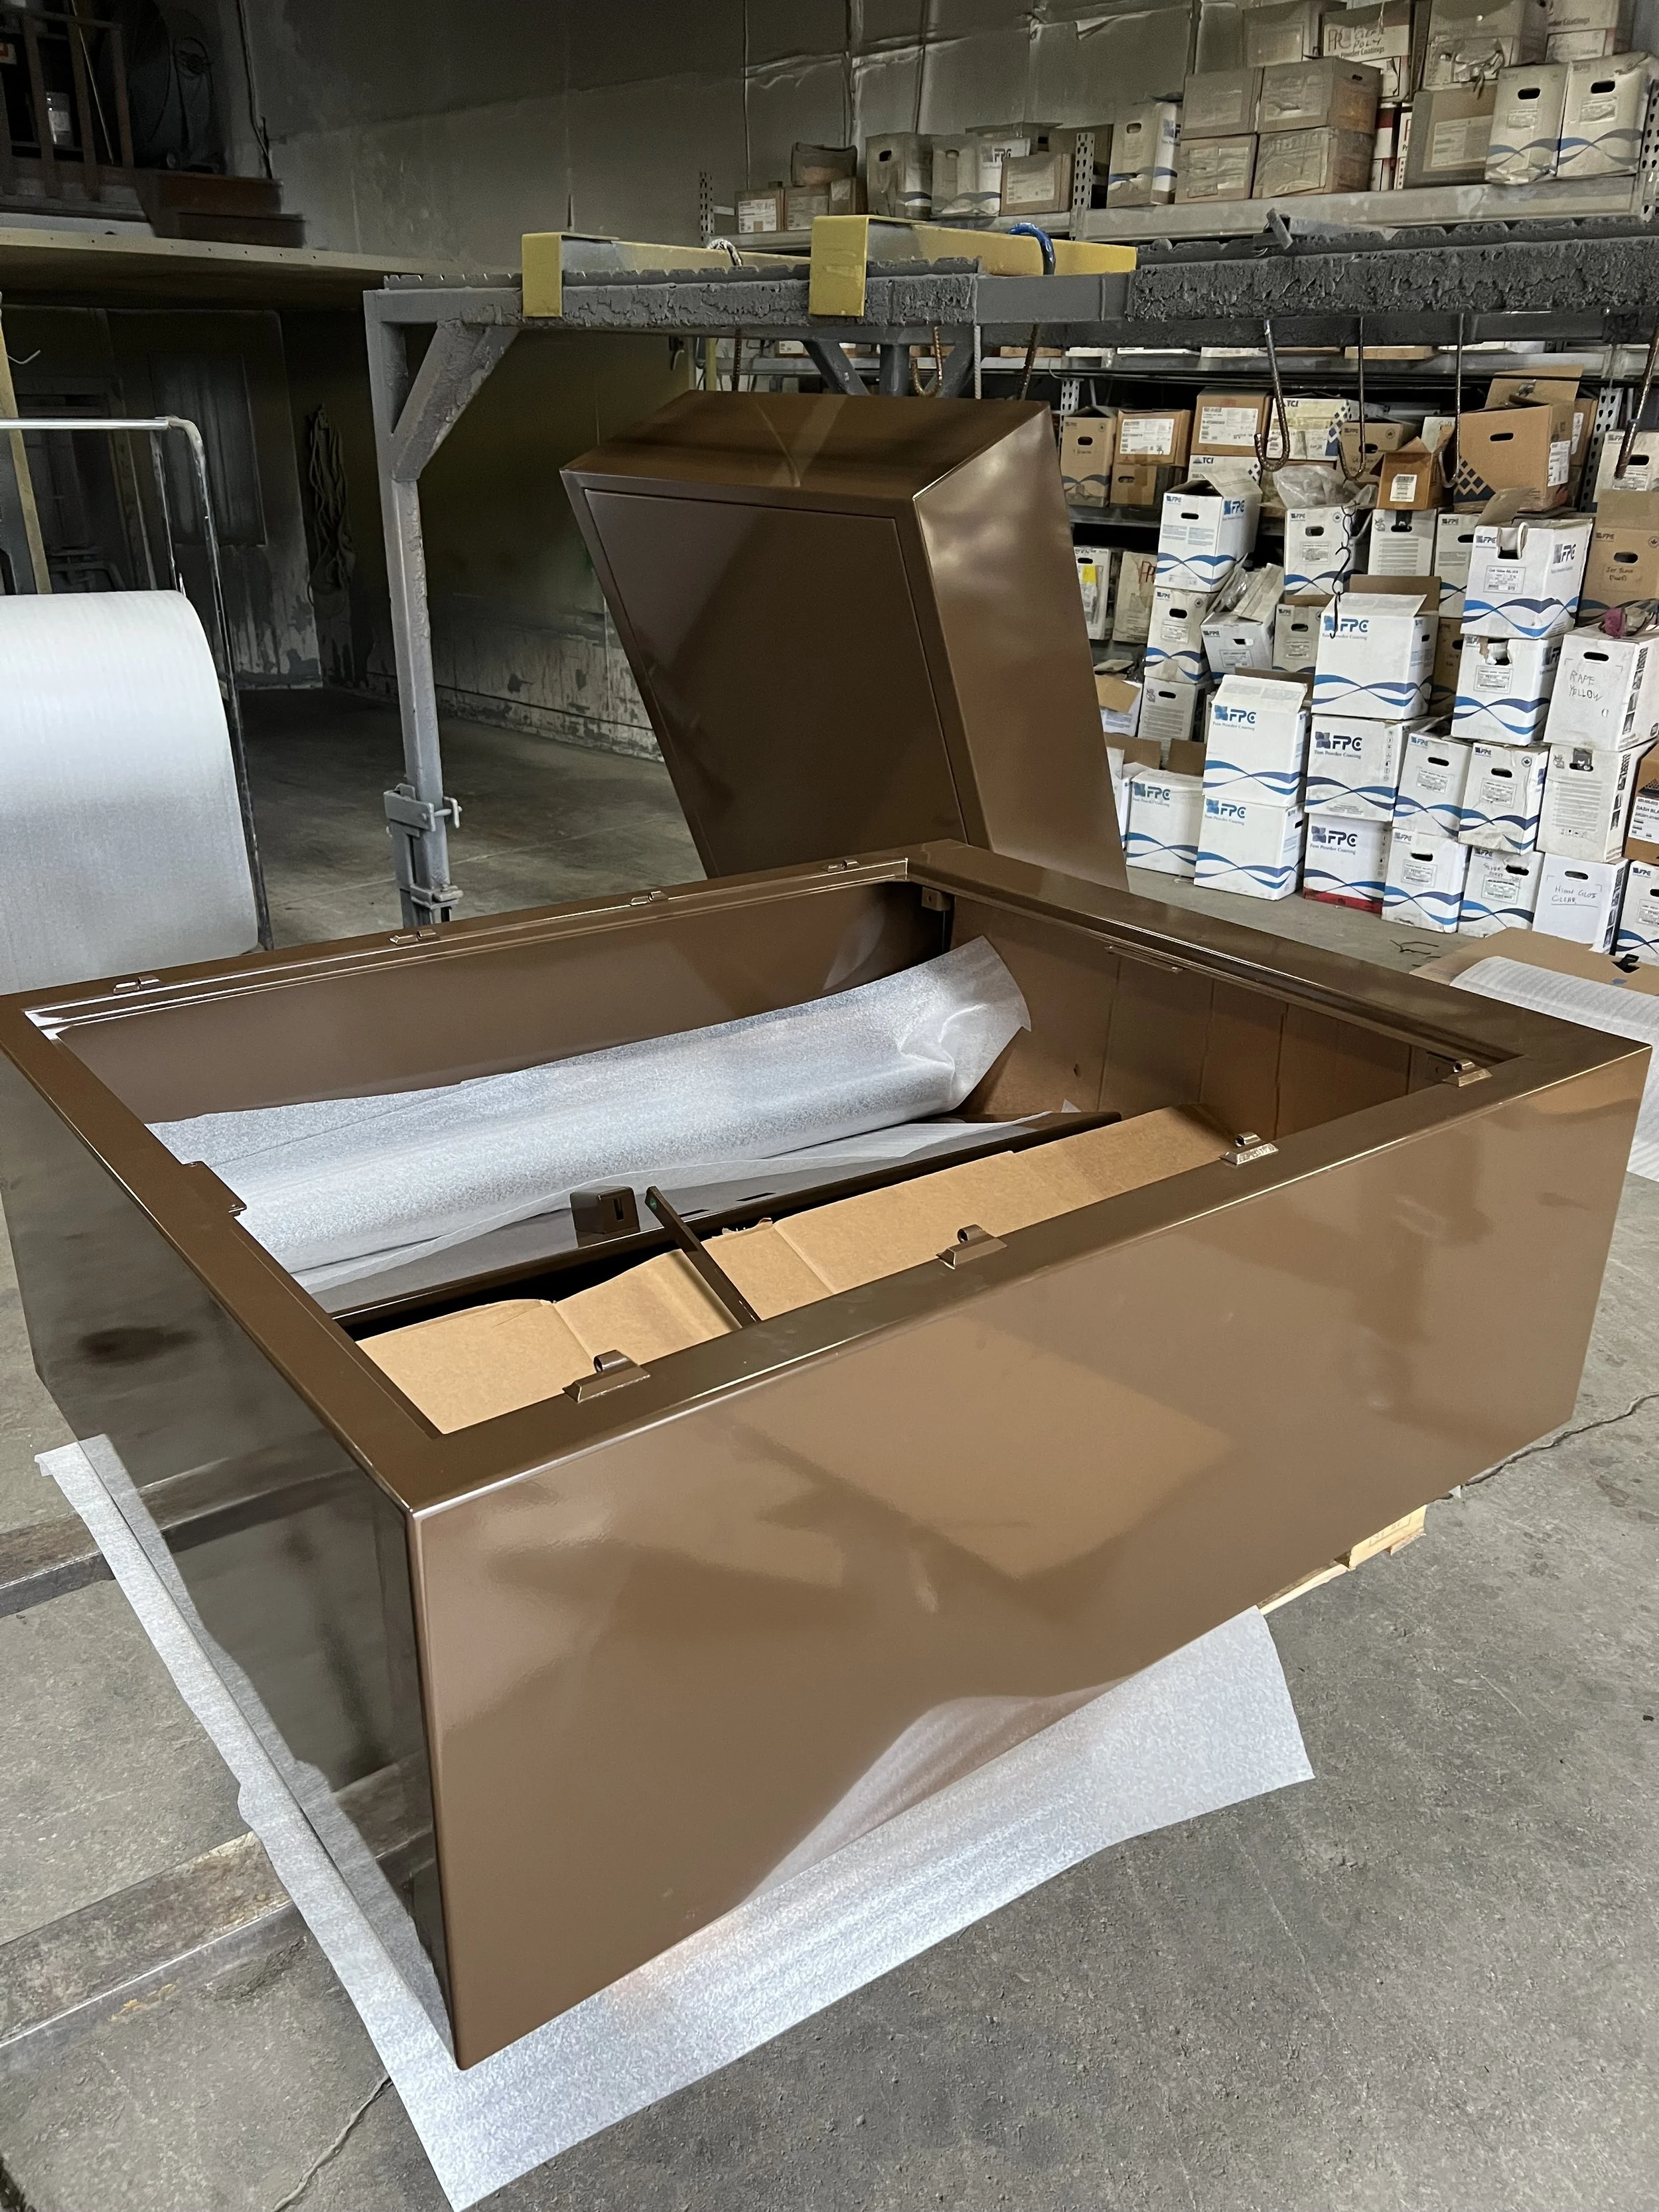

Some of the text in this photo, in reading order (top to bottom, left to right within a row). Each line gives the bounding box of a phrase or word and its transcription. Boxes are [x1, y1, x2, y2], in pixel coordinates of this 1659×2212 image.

[1360, 46, 1385, 56] Coatings
[1231, 500, 1246, 514] FPC
[1561, 544, 1577, 563] FPC
[1340, 618, 1370, 633] FPC
[1569, 670, 1595, 686] RAPE
[1569, 685, 1603, 701] YELLOW
[1229, 709, 1257, 724] FPC
[1332, 735, 1363, 751] FPC
[1146, 786, 1171, 801] FPC
[1220, 803, 1246, 819] FPC
[1327, 830, 1358, 848] FPC
[1551, 895, 1577, 904] CLEAR
